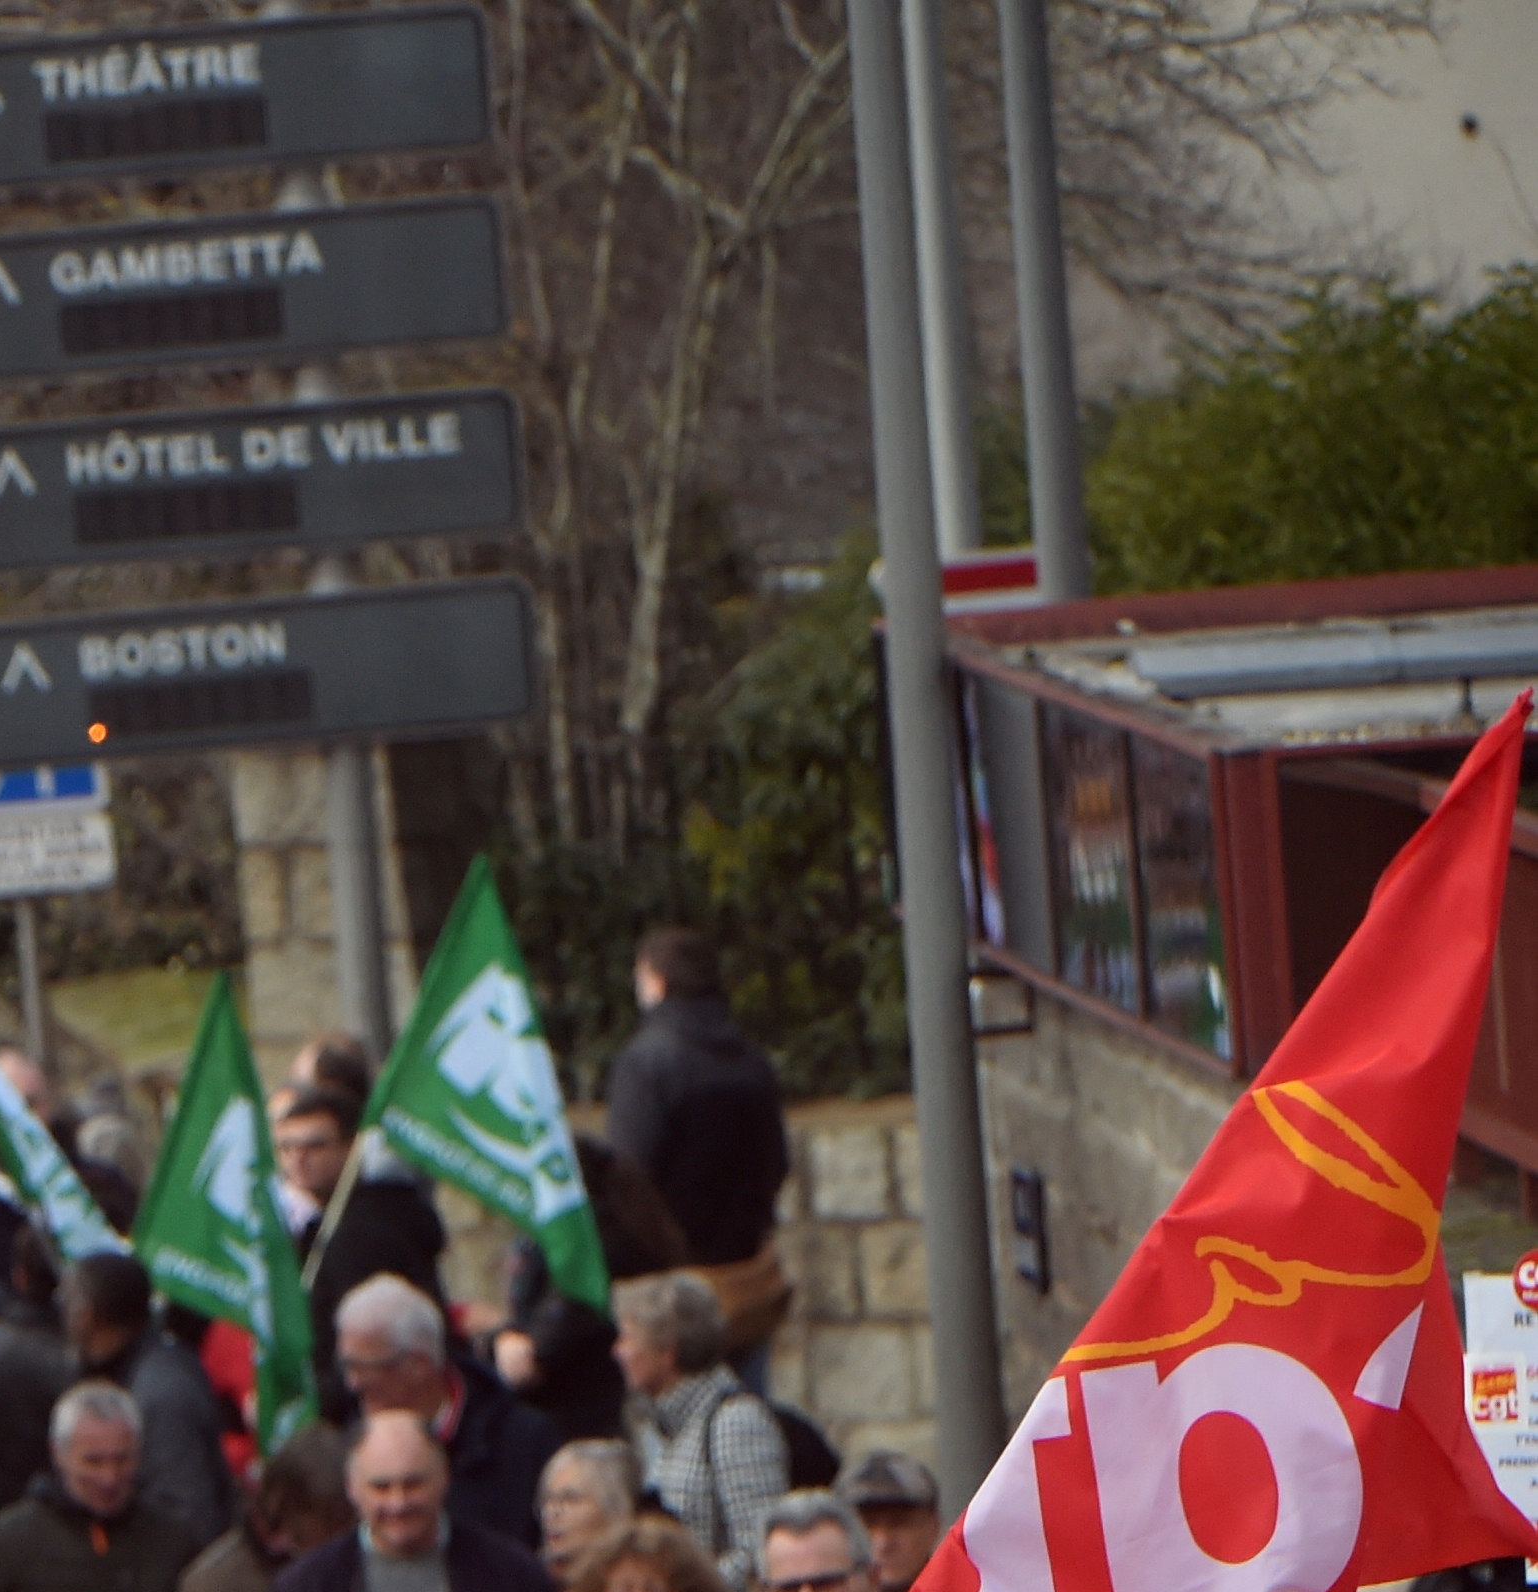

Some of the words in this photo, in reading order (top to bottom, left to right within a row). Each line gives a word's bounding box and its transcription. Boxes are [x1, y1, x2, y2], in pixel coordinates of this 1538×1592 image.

[34, 42, 262, 100] THÉÂTRE
[49, 231, 323, 294] GAMBETTA
[66, 426, 231, 485] HÔTEL
[243, 426, 312, 470] DE
[324, 412, 462, 462] VILLE
[78, 621, 286, 678] BOSTON
